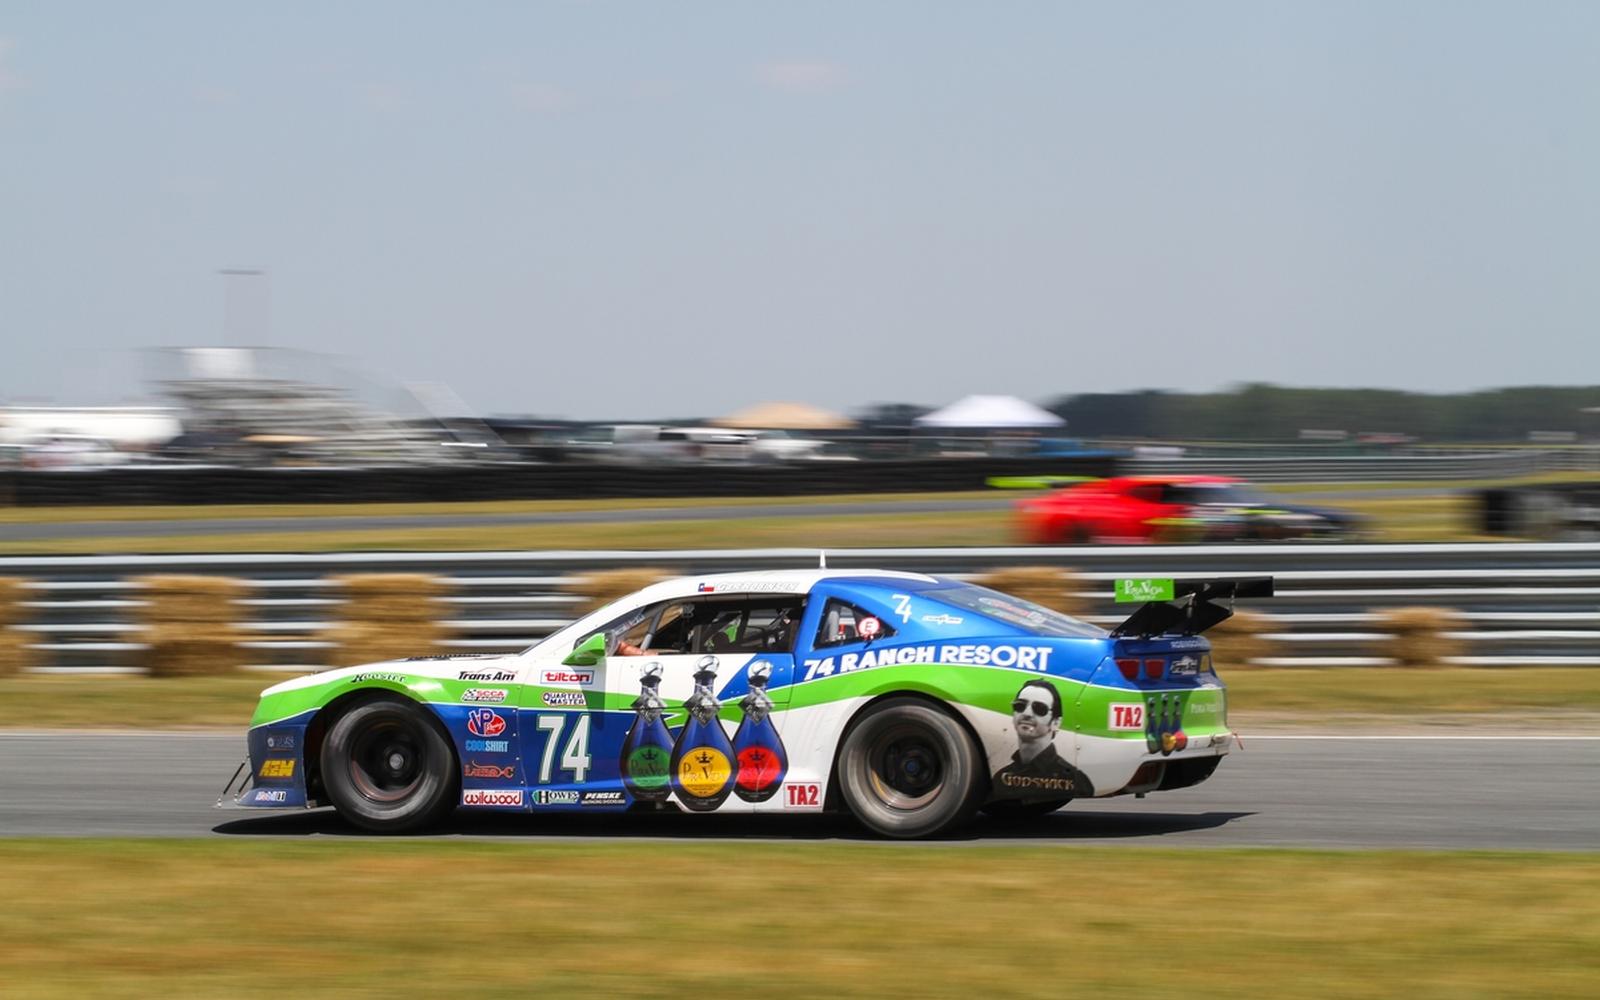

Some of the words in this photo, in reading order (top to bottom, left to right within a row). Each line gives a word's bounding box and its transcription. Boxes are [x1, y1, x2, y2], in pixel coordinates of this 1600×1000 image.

[803, 657, 835, 681] 74
[840, 646, 935, 671] RANCH
[940, 645, 1052, 671] RESORT
[458, 671, 492, 681] Trans
[493, 672, 515, 681] Am
[545, 672, 590, 682] tilton
[543, 692, 584, 702] QUARTER
[1114, 707, 1142, 727] TA2
[465, 740, 509, 752] COOLSHIRT
[536, 713, 592, 784] 74
[464, 791, 522, 805] wilwood
[787, 785, 818, 805] TA2
